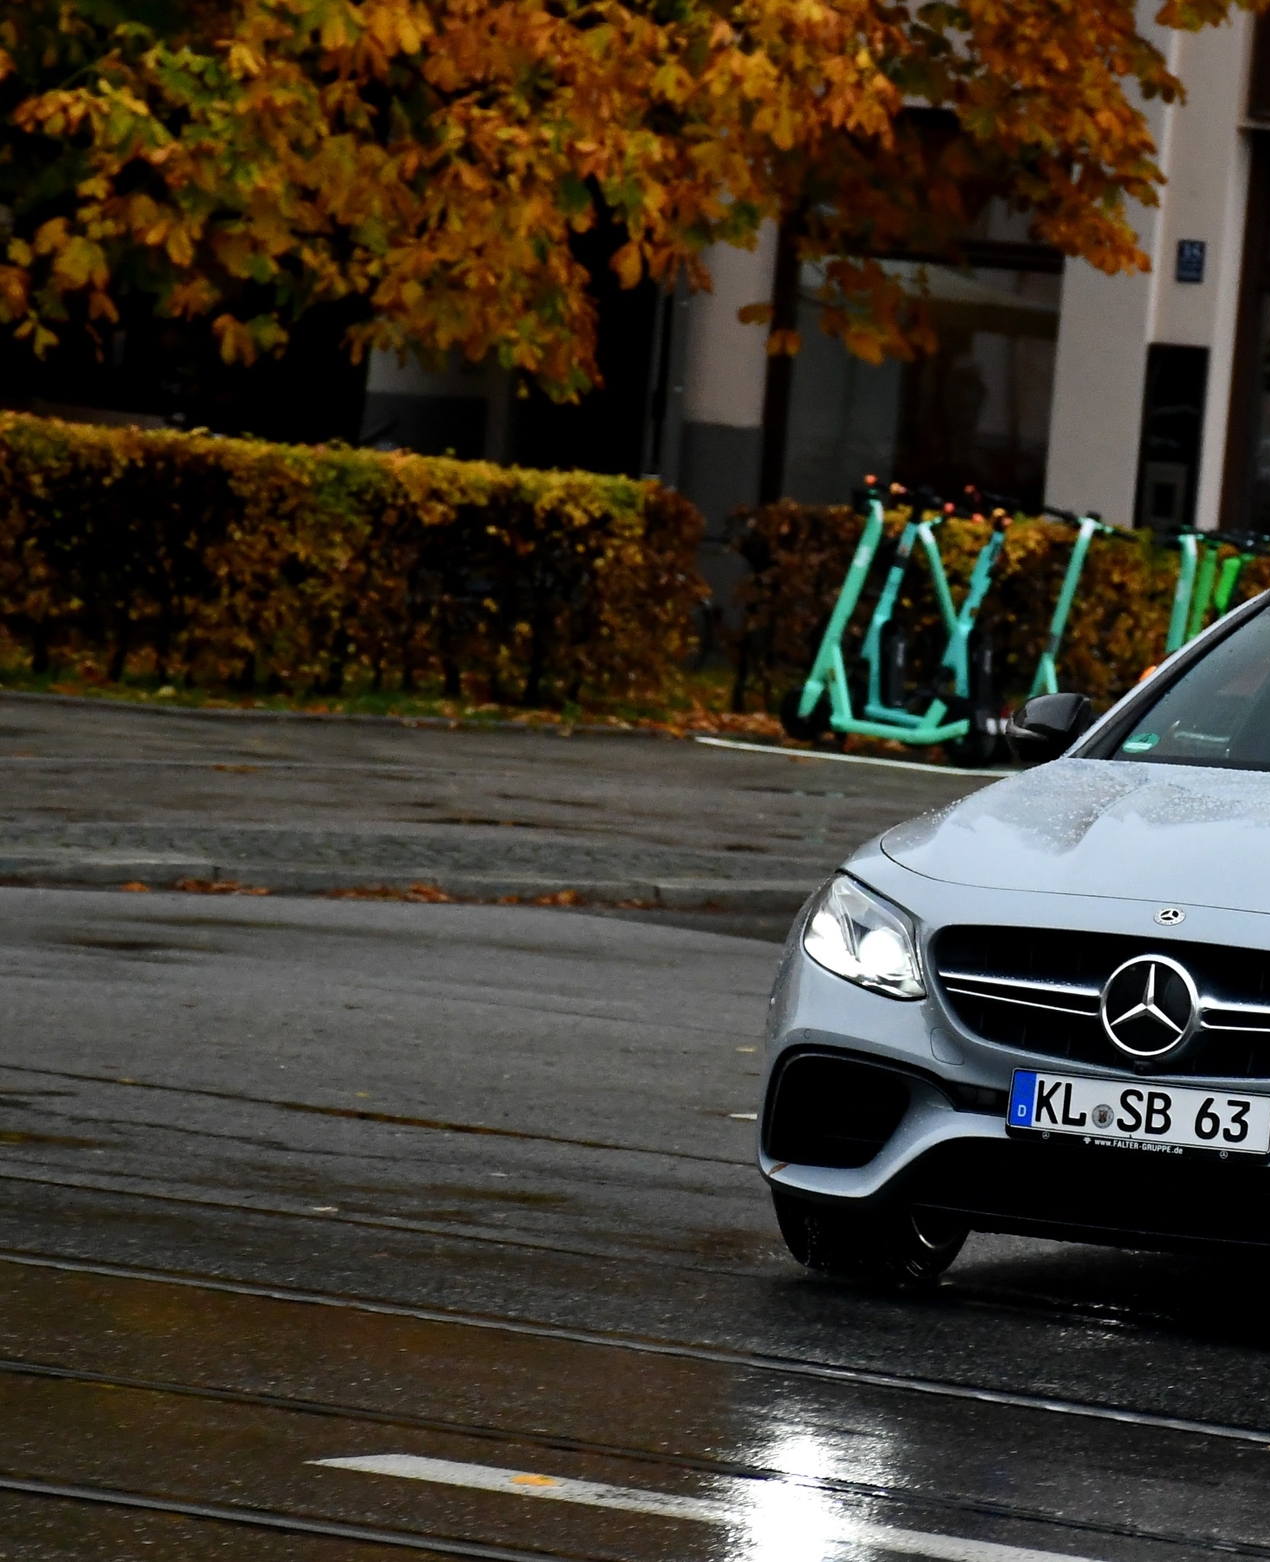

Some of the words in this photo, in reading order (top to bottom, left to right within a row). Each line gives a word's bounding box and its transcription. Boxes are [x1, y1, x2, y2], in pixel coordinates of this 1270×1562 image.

[1018, 1104, 1026, 1117] D
[1035, 1080, 1086, 1126] KL
[1116, 1088, 1172, 1135] SB
[1194, 1097, 1251, 1143] 63
[1094, 1139, 1183, 1155] www.FALTER-GRUPPE.de
